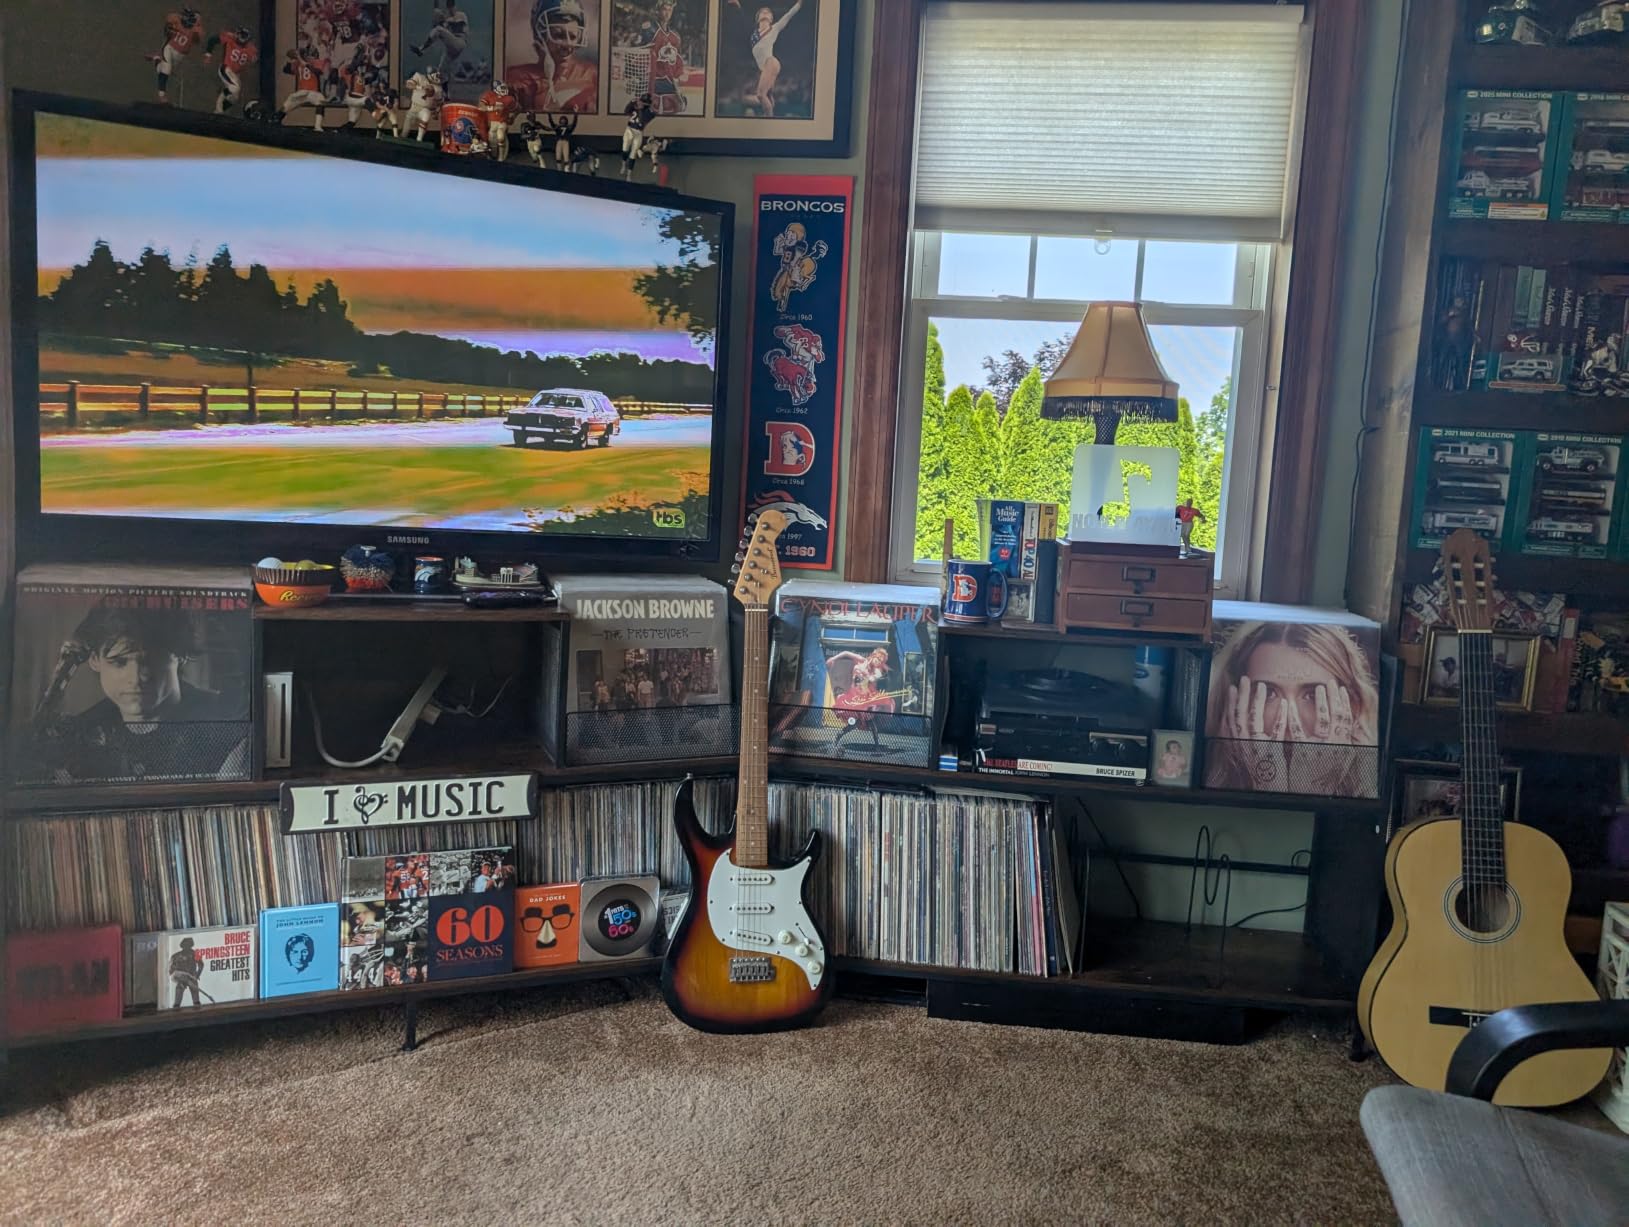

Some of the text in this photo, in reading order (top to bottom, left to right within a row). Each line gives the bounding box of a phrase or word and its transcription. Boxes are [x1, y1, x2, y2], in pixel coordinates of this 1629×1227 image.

[1512, 91, 1552, 100] COLLECTION
[760, 200, 845, 213] BRONCOS
[798, 313, 813, 321] 1960
[792, 407, 808, 415] 1962
[1444, 430, 1458, 438] 2021
[1475, 432, 1516, 442] COLLECTION
[656, 511, 683, 525] tbs
[996, 508, 1019, 518] Music
[997, 515, 1017, 523] Guide
[387, 535, 430, 545] SAMSUNG
[787, 532, 803, 540] 1997
[785, 546, 816, 556] 1960
[1023, 556, 1036, 568] 40
[23, 586, 248, 598] ORIGINAL MOTION PICTURE SOUNDTRACK
[575, 599, 715, 620] JACKSON BROWNE
[780, 597, 939, 625] CYNDI LAUPER
[602, 627, 689, 641] THE PRETENDER
[989, 768, 1014, 776] IMMORTAL
[1018, 760, 1029, 769] ARE
[1029, 761, 1053, 771] COMING!
[1096, 767, 1115, 776] BRUCE
[1115, 769, 1135, 777] SPIZER
[323, 780, 505, 825] I MUSIC
[276, 919, 324, 929] JOHN LENNON
[613, 909, 637, 926] 50s
[435, 904, 505, 947] 60
[608, 924, 635, 938] 60s
[224, 931, 251, 946] BRUCE
[194, 944, 251, 961] SPRINGSTEEN
[436, 944, 504, 962] SEASONS
[210, 957, 251, 972] GREATEST
[231, 969, 251, 982] HITS
